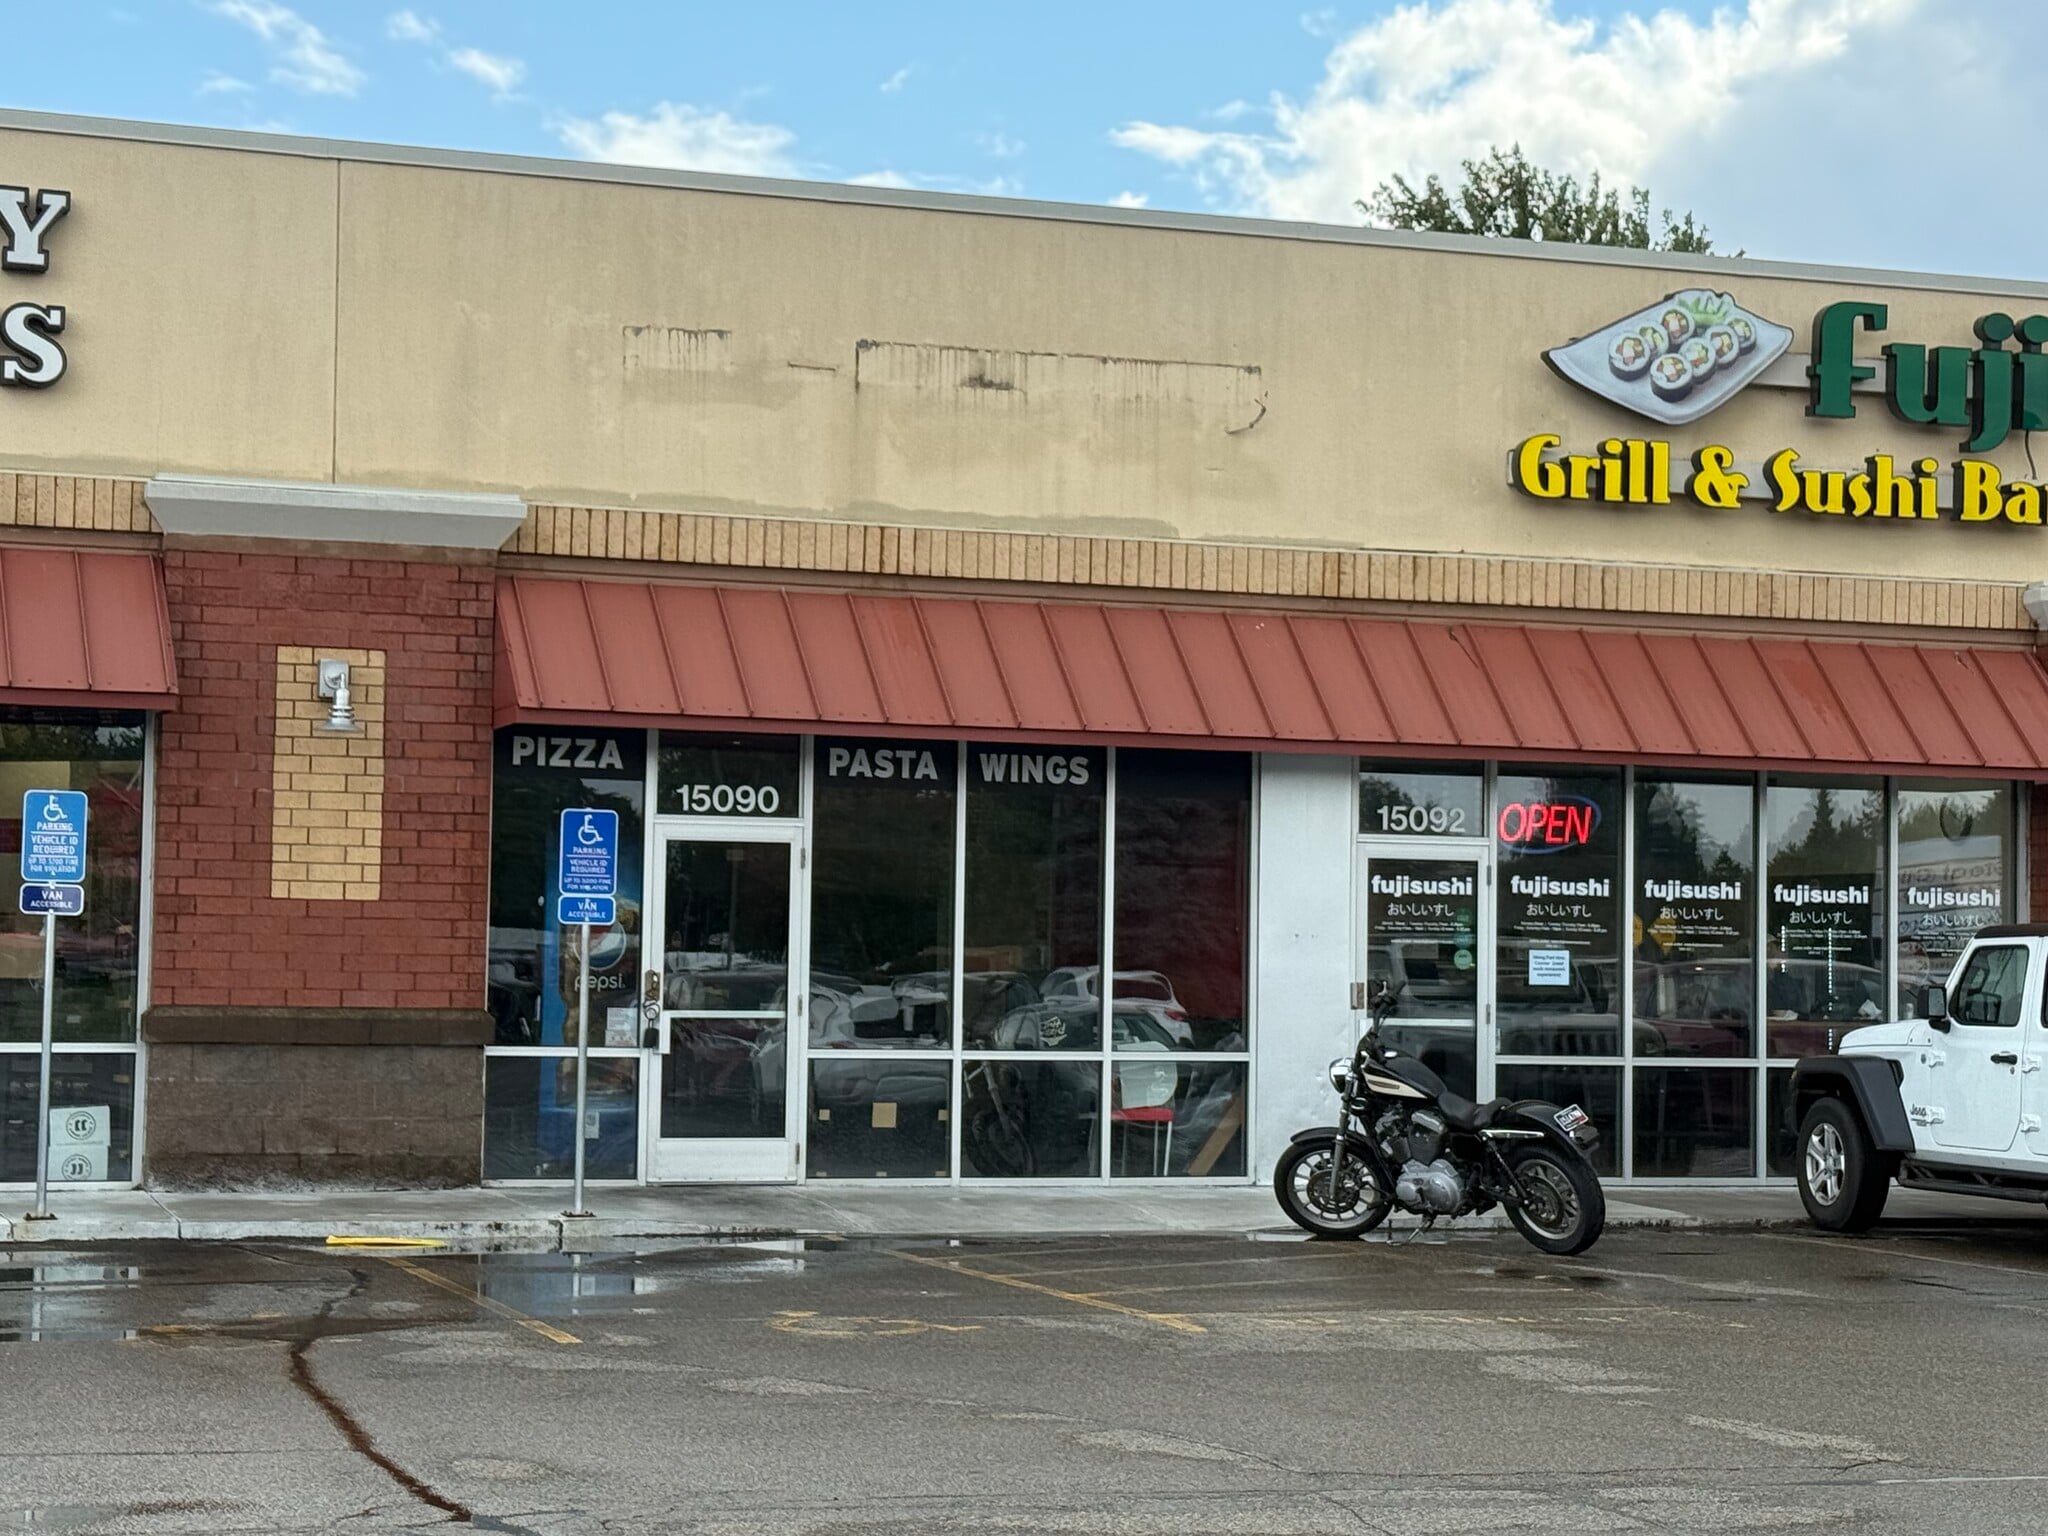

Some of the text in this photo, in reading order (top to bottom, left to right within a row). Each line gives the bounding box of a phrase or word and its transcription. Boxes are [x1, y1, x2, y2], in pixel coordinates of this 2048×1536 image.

[0, 184, 71, 273] Y
[0, 302, 68, 389] S
[1805, 301, 2048, 453] fuji
[1515, 433, 2048, 525] Grill & Sushi Ba
[512, 736, 623, 770] PIZZA
[828, 747, 938, 780] PASTA
[980, 752, 1090, 785] WINGS
[676, 784, 780, 814] 15090
[37, 822, 73, 831] PARKING
[1377, 805, 1466, 832] 15092
[1498, 802, 1594, 845] OPEN
[31, 835, 78, 845] VEHICLE ID
[33, 846, 75, 855] REQUIRED
[573, 847, 607, 855] PARKING
[42, 890, 63, 899] VAN
[1371, 875, 1473, 897] fujisushi
[1510, 875, 1610, 897] fujisushi
[1644, 879, 1741, 902] fujisushi
[1774, 883, 1869, 906] fujisushi
[1907, 886, 2001, 908] fujisushi
[30, 901, 73, 909] ACCESSIBLE
[568, 910, 606, 918] ACCESSIBLE
[578, 902, 597, 910] VAN
[1388, 902, 1454, 916] おいしいすし
[1526, 903, 1592, 917] おいしいすし
[1660, 906, 1724, 920] おいしいすし
[1789, 911, 1853, 924] おいしいすし
